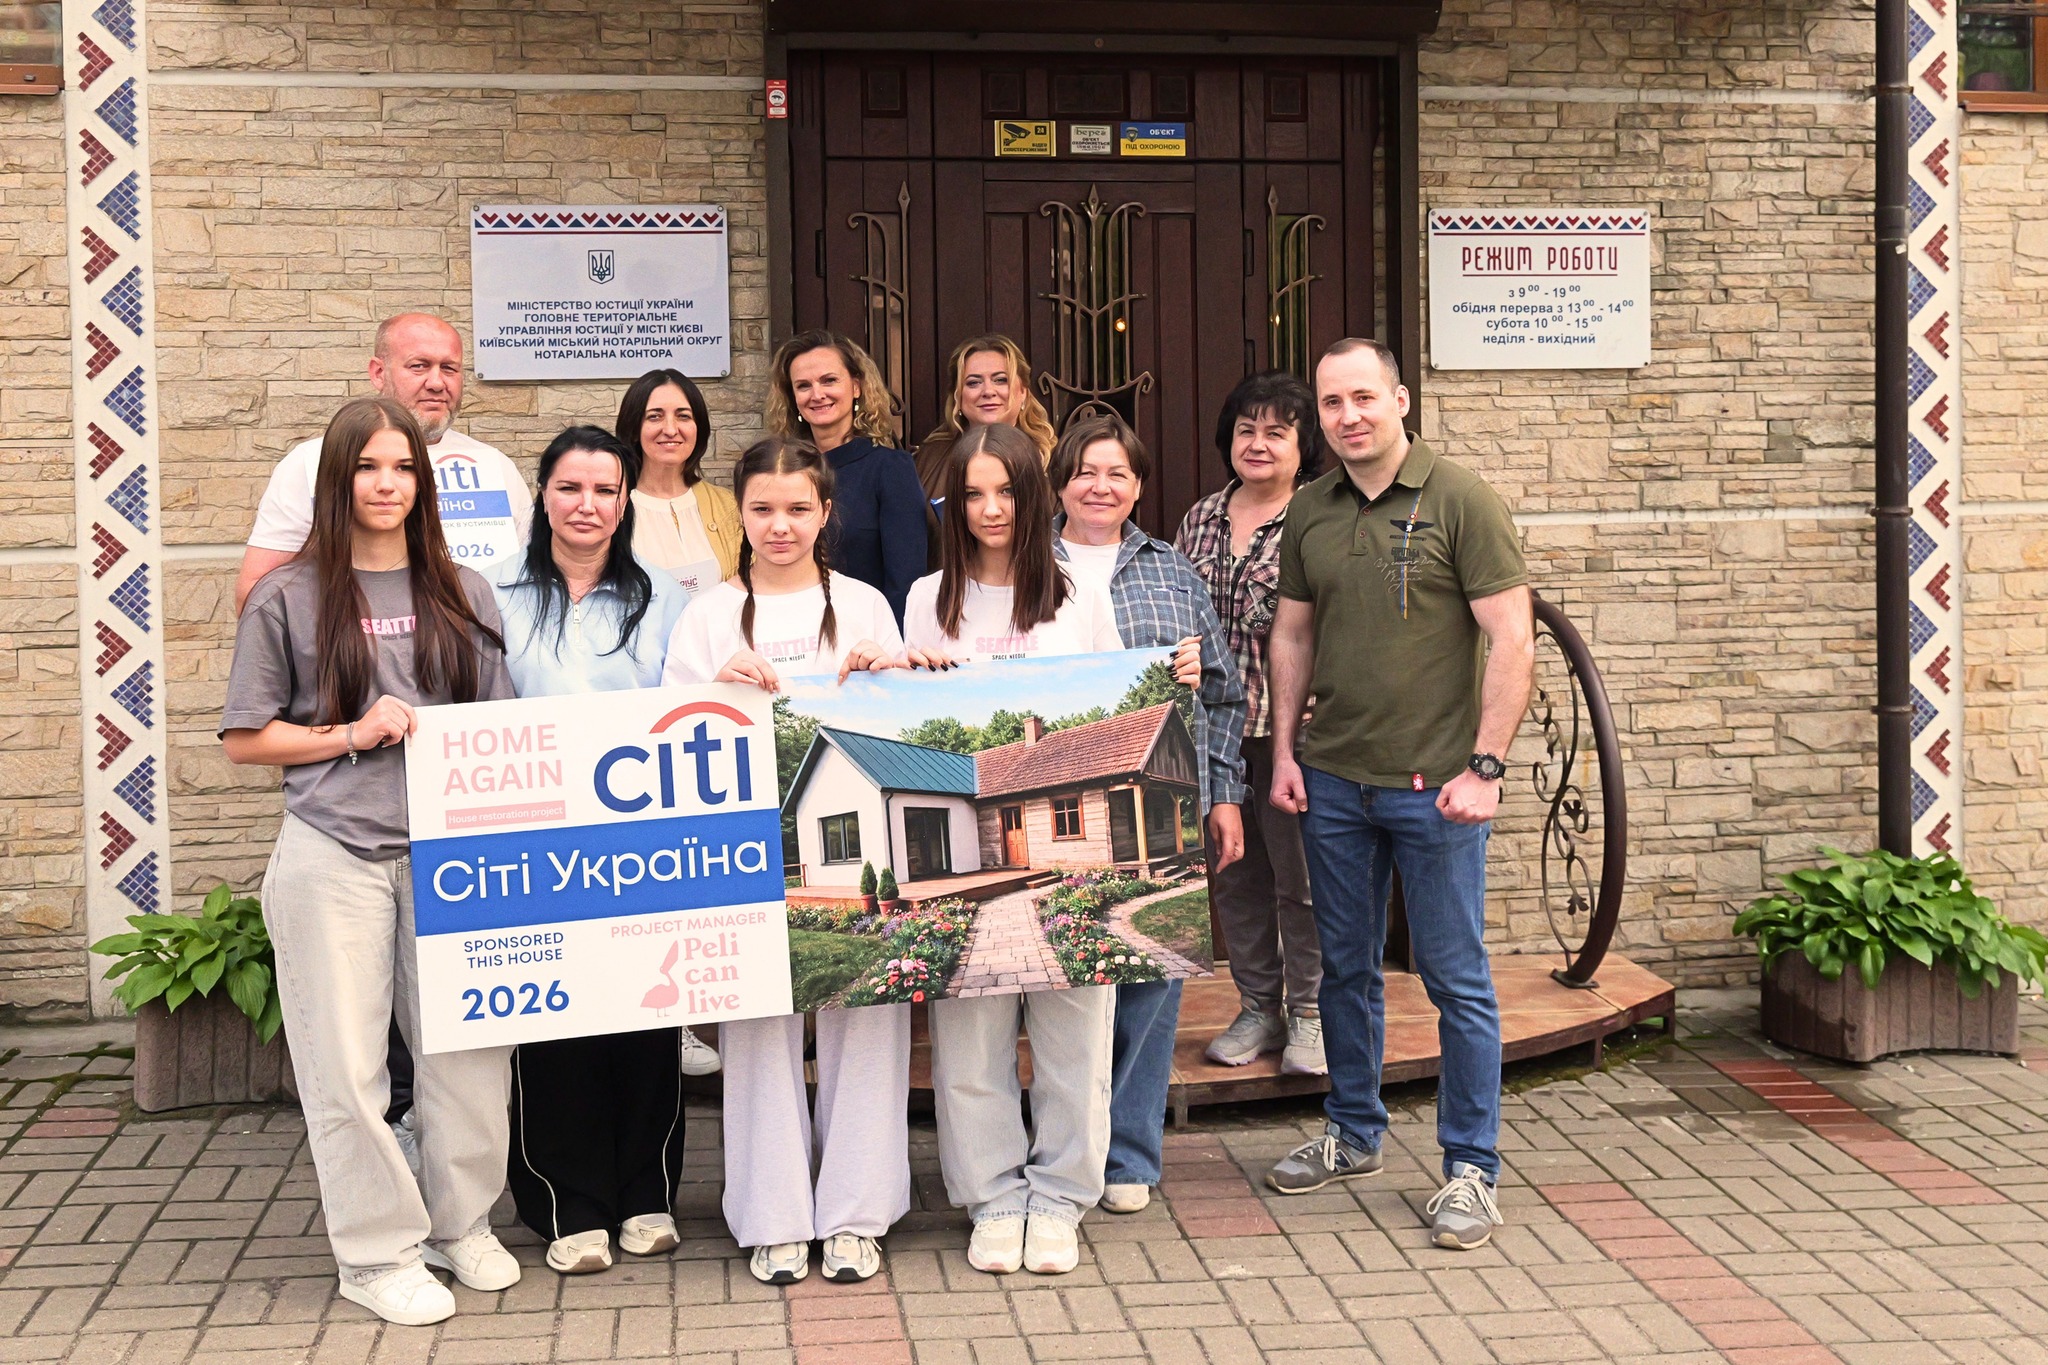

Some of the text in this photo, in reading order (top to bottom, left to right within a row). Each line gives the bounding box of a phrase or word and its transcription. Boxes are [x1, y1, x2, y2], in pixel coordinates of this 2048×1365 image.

[1462, 247, 1618, 271] РЕЖИМ РОБОТИ
[507, 299, 694, 312] МІНІСТЕРСТВО ЮСТИЦІЇ УКРАЇНИ
[1452, 302, 1496, 314] обідня
[1500, 304, 1553, 316] перерва
[524, 312, 677, 323] ГОЛОВНЕ ТЕРИТОРІАЛЬНЕ
[1486, 317, 1530, 331] субота
[498, 324, 703, 336] УПРАВЛІННЯ ЮСТИЦІЇ У МІСТІ КИЄВІ
[1482, 333, 1525, 345] неділя
[1537, 332, 1596, 345] вихідний
[479, 335, 722, 348] КИЇВСЬКИЙ МІСЬКИЙ НОТАРІЛЬНИЙ ОКРУГ
[534, 348, 673, 359] НОТАРІАЛЬНА КОНТОРА
[433, 461, 480, 490] iti
[437, 498, 475, 512] їна
[448, 543, 494, 558] 2026
[754, 636, 818, 657] SEATTLE
[975, 635, 1039, 653] SEATTLE
[789, 653, 806, 661] NEEDLE
[442, 724, 557, 759] HOME
[593, 720, 753, 813] citi
[443, 759, 563, 796] AGAIN
[448, 805, 564, 825] House restoration project
[433, 837, 768, 902] Сіті Україна
[611, 911, 767, 938] PROJECT MANAGER
[464, 932, 564, 953] SPONSORED
[684, 932, 740, 961] Peli
[467, 948, 563, 969] THIS HOUSE
[685, 964, 739, 985] can
[462, 980, 570, 1021] 2026
[687, 988, 741, 1015] live
